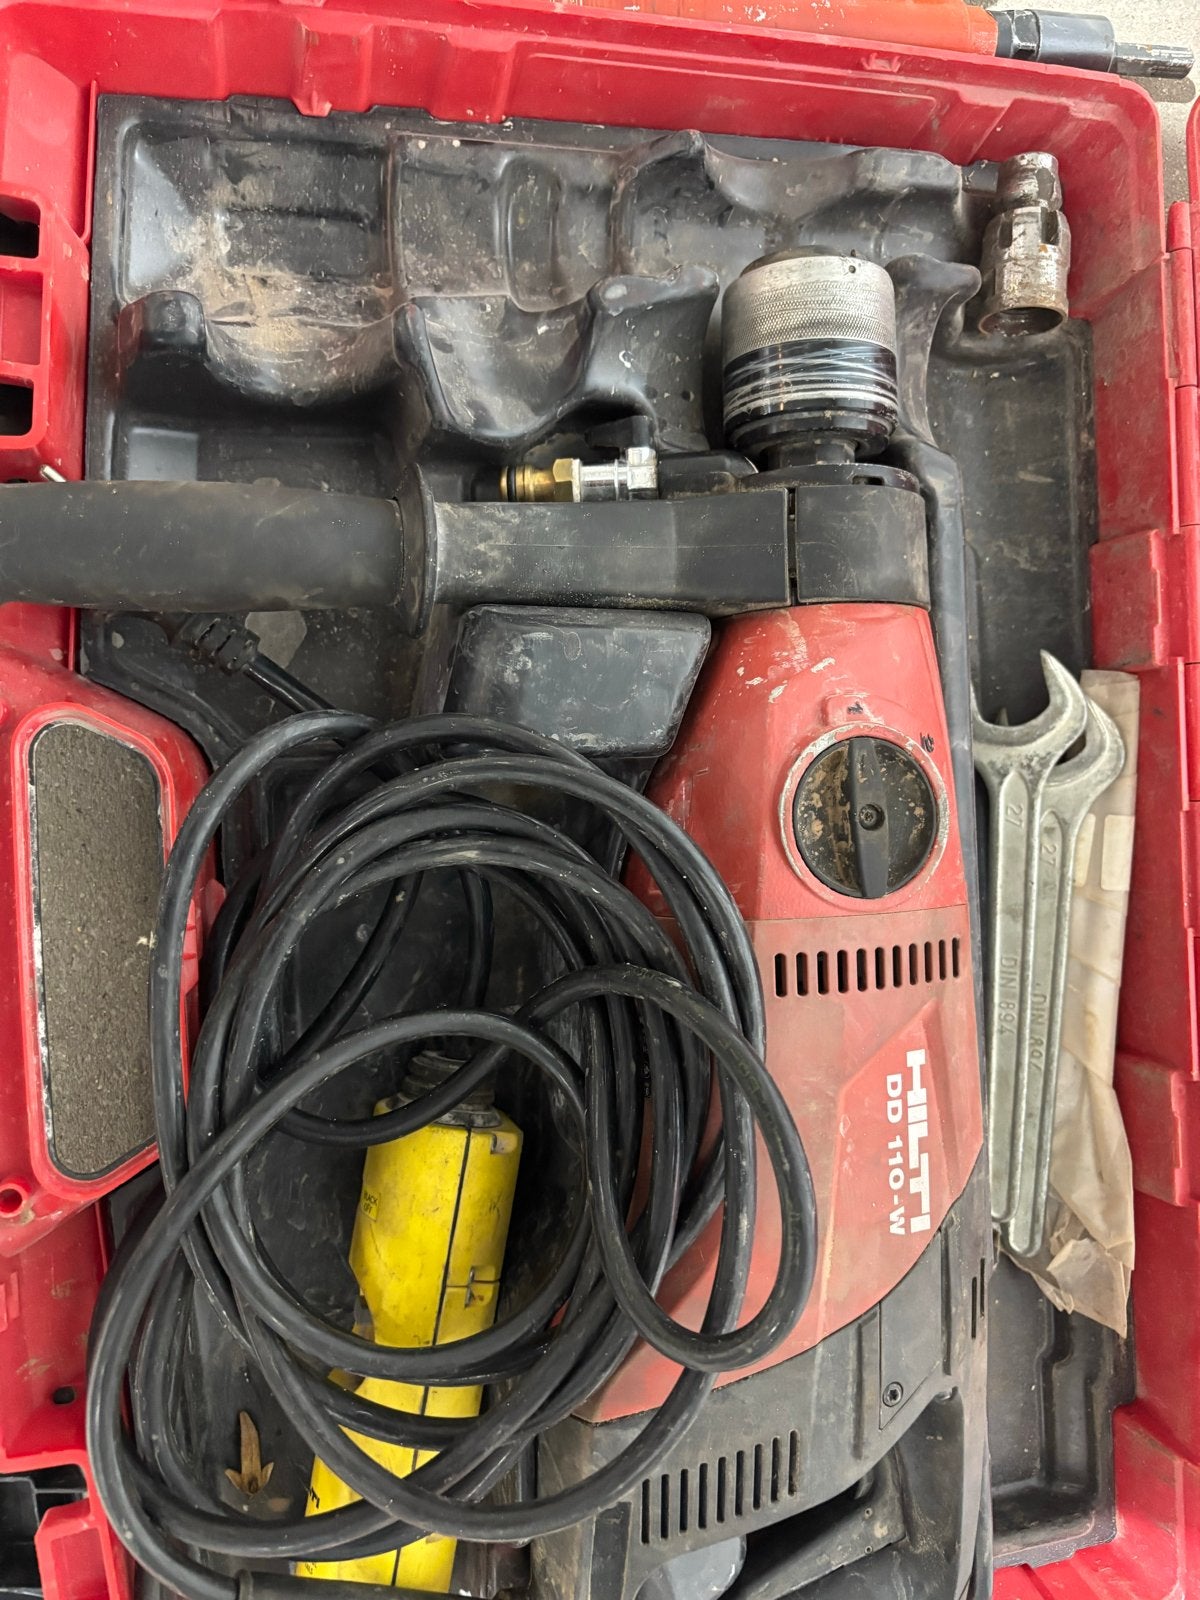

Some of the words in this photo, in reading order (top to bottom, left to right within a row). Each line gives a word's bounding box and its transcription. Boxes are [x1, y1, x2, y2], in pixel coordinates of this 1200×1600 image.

[1004, 803, 1024, 829] 27
[1040, 844, 1057, 868] 27
[1000, 956, 1018, 989] DIN
[998, 1001, 1016, 1035] 894
[1030, 993, 1047, 1026] DIN
[886, 1073, 903, 1124] DD
[906, 1049, 931, 1234] HILTI
[887, 1135, 906, 1236] 110-W
